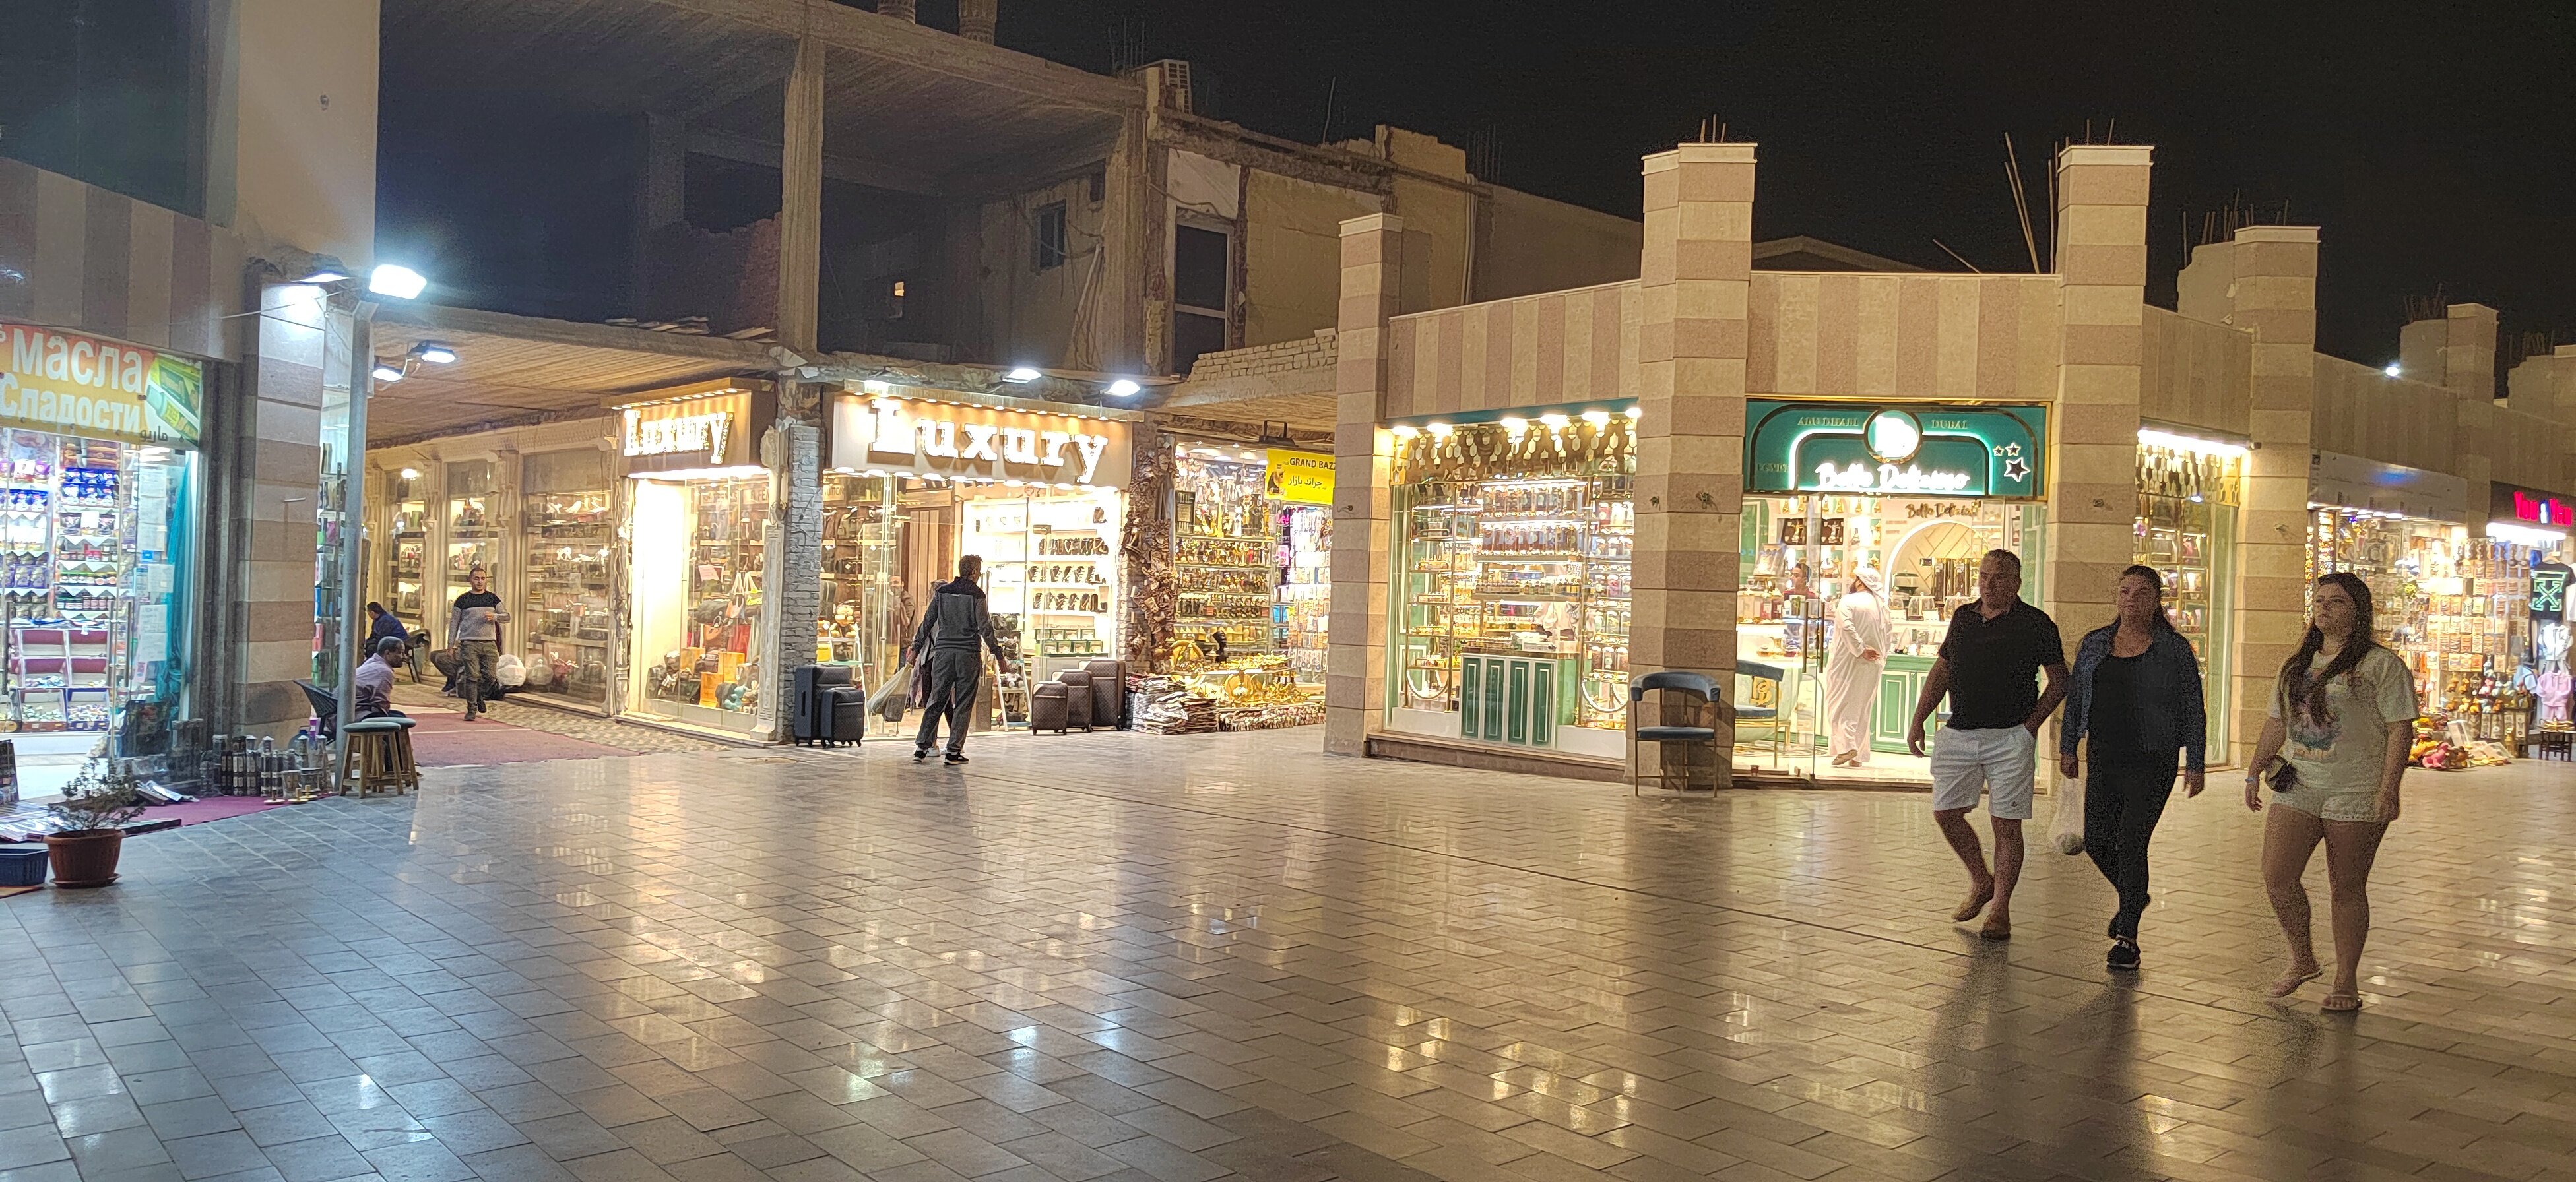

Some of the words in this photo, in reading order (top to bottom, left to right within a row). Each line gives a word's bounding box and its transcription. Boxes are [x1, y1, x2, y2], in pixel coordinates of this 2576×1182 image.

[13, 328, 143, 394] Масла
[0, 372, 141, 433] Сладости
[624, 409, 734, 464] Luxury
[867, 398, 1109, 483] Luxury
[1289, 457, 1317, 468] GRAND
